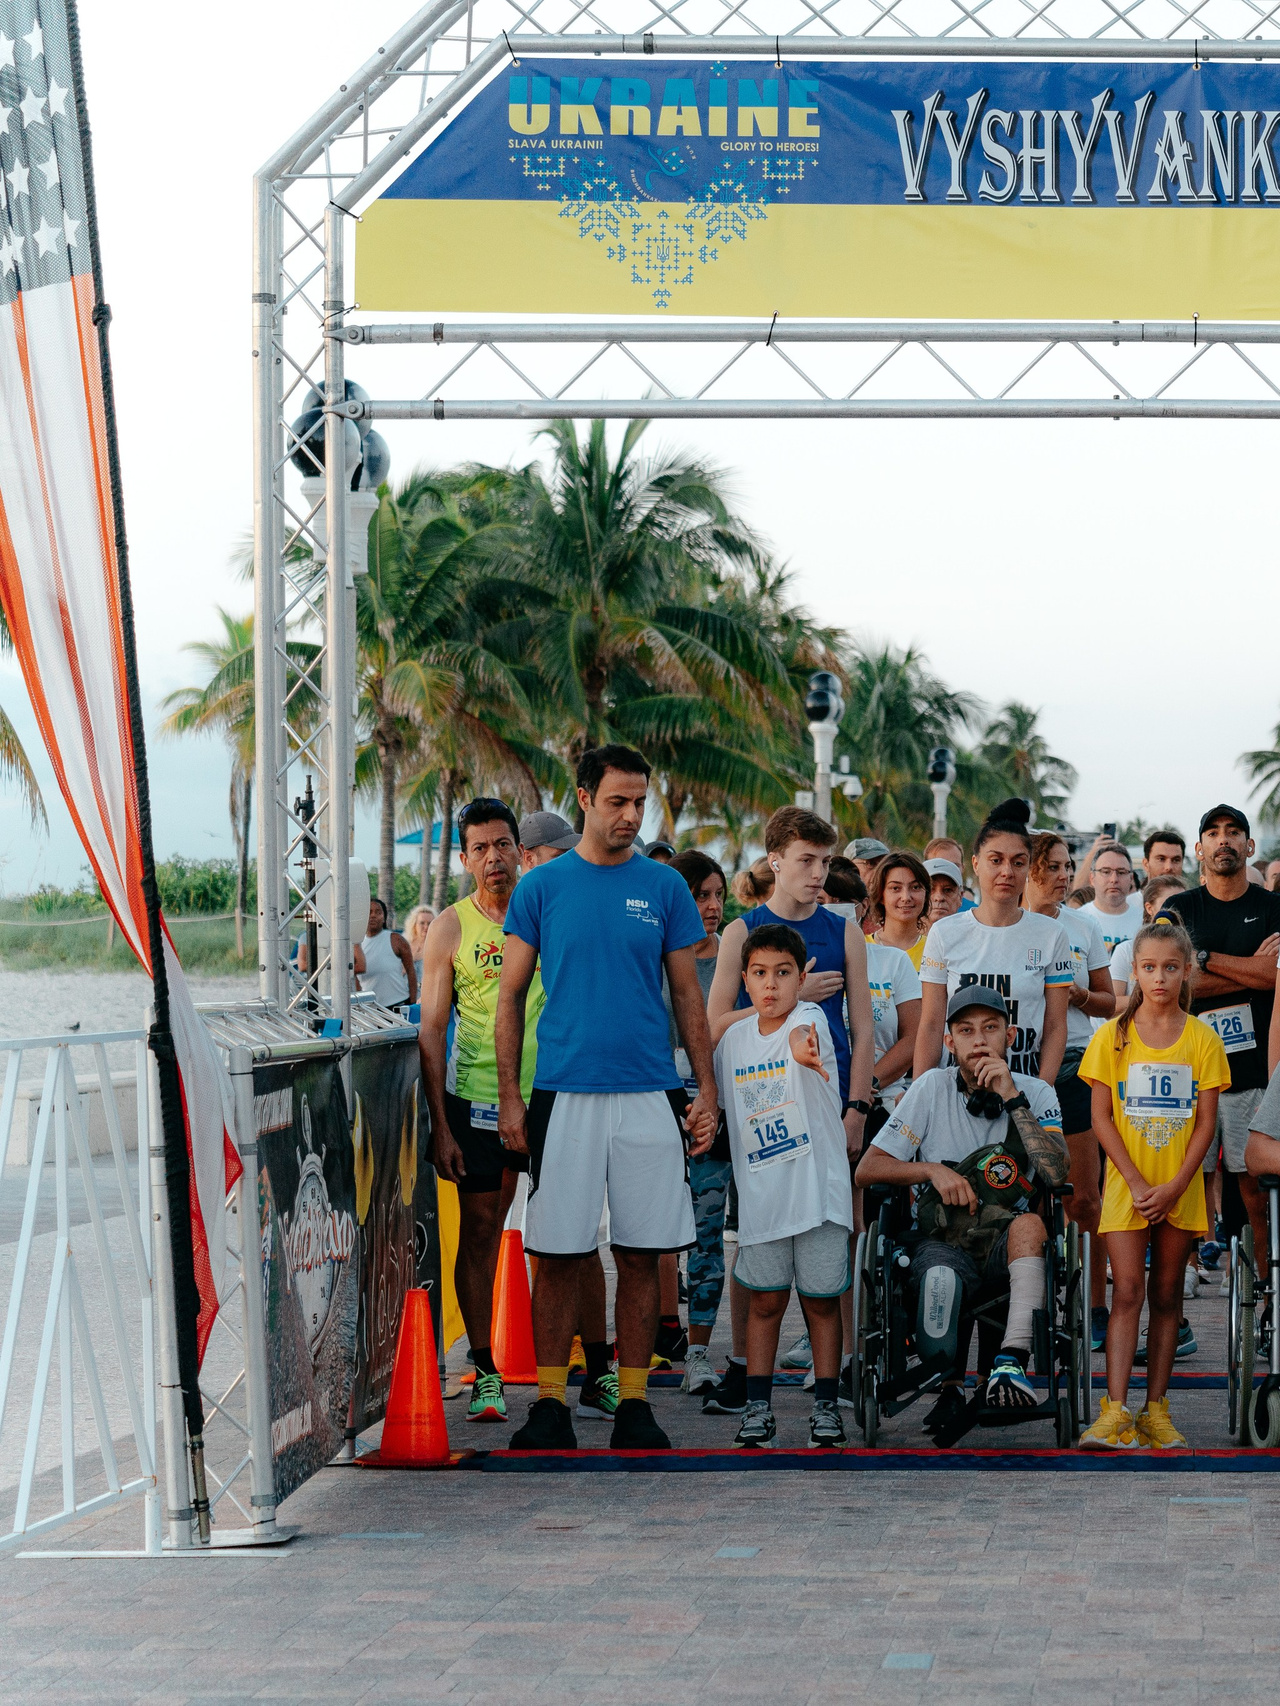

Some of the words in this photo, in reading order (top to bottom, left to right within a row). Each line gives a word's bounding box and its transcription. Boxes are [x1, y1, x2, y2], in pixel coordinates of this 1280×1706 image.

[508, 76, 821, 138] UKRAINE
[508, 138, 548, 149] SLAVA
[551, 139, 604, 150] UKRAINI!
[720, 140, 757, 152] GLORY
[758, 141, 774, 152] TO
[776, 141, 820, 153] HEROES!
[626, 898, 649, 909] NSU
[926, 957, 946, 971] Step
[1210, 1015, 1243, 1037] 126
[1148, 1075, 1172, 1097] 16
[754, 1118, 789, 1147] 145
[900, 1124, 921, 1147] Step
